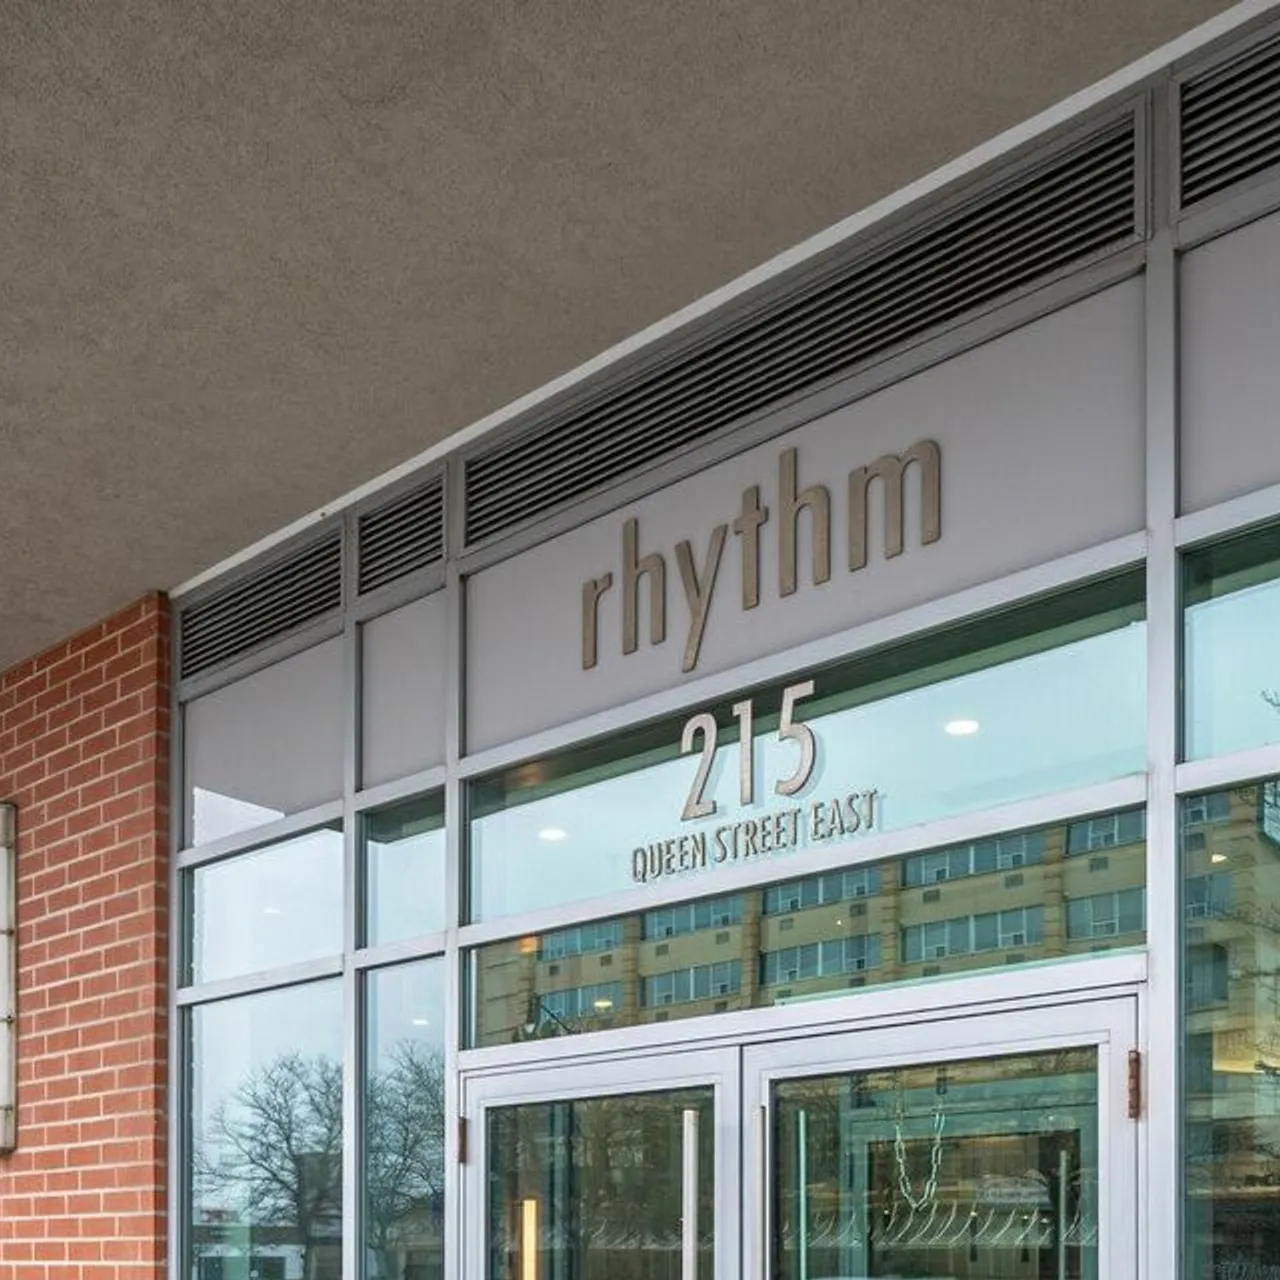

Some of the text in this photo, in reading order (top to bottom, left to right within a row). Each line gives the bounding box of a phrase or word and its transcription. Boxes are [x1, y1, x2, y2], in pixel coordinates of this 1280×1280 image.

[581, 439, 941, 673] rhythm
[680, 679, 817, 821] 215
[631, 787, 880, 884] QUEEN STREET EAST
